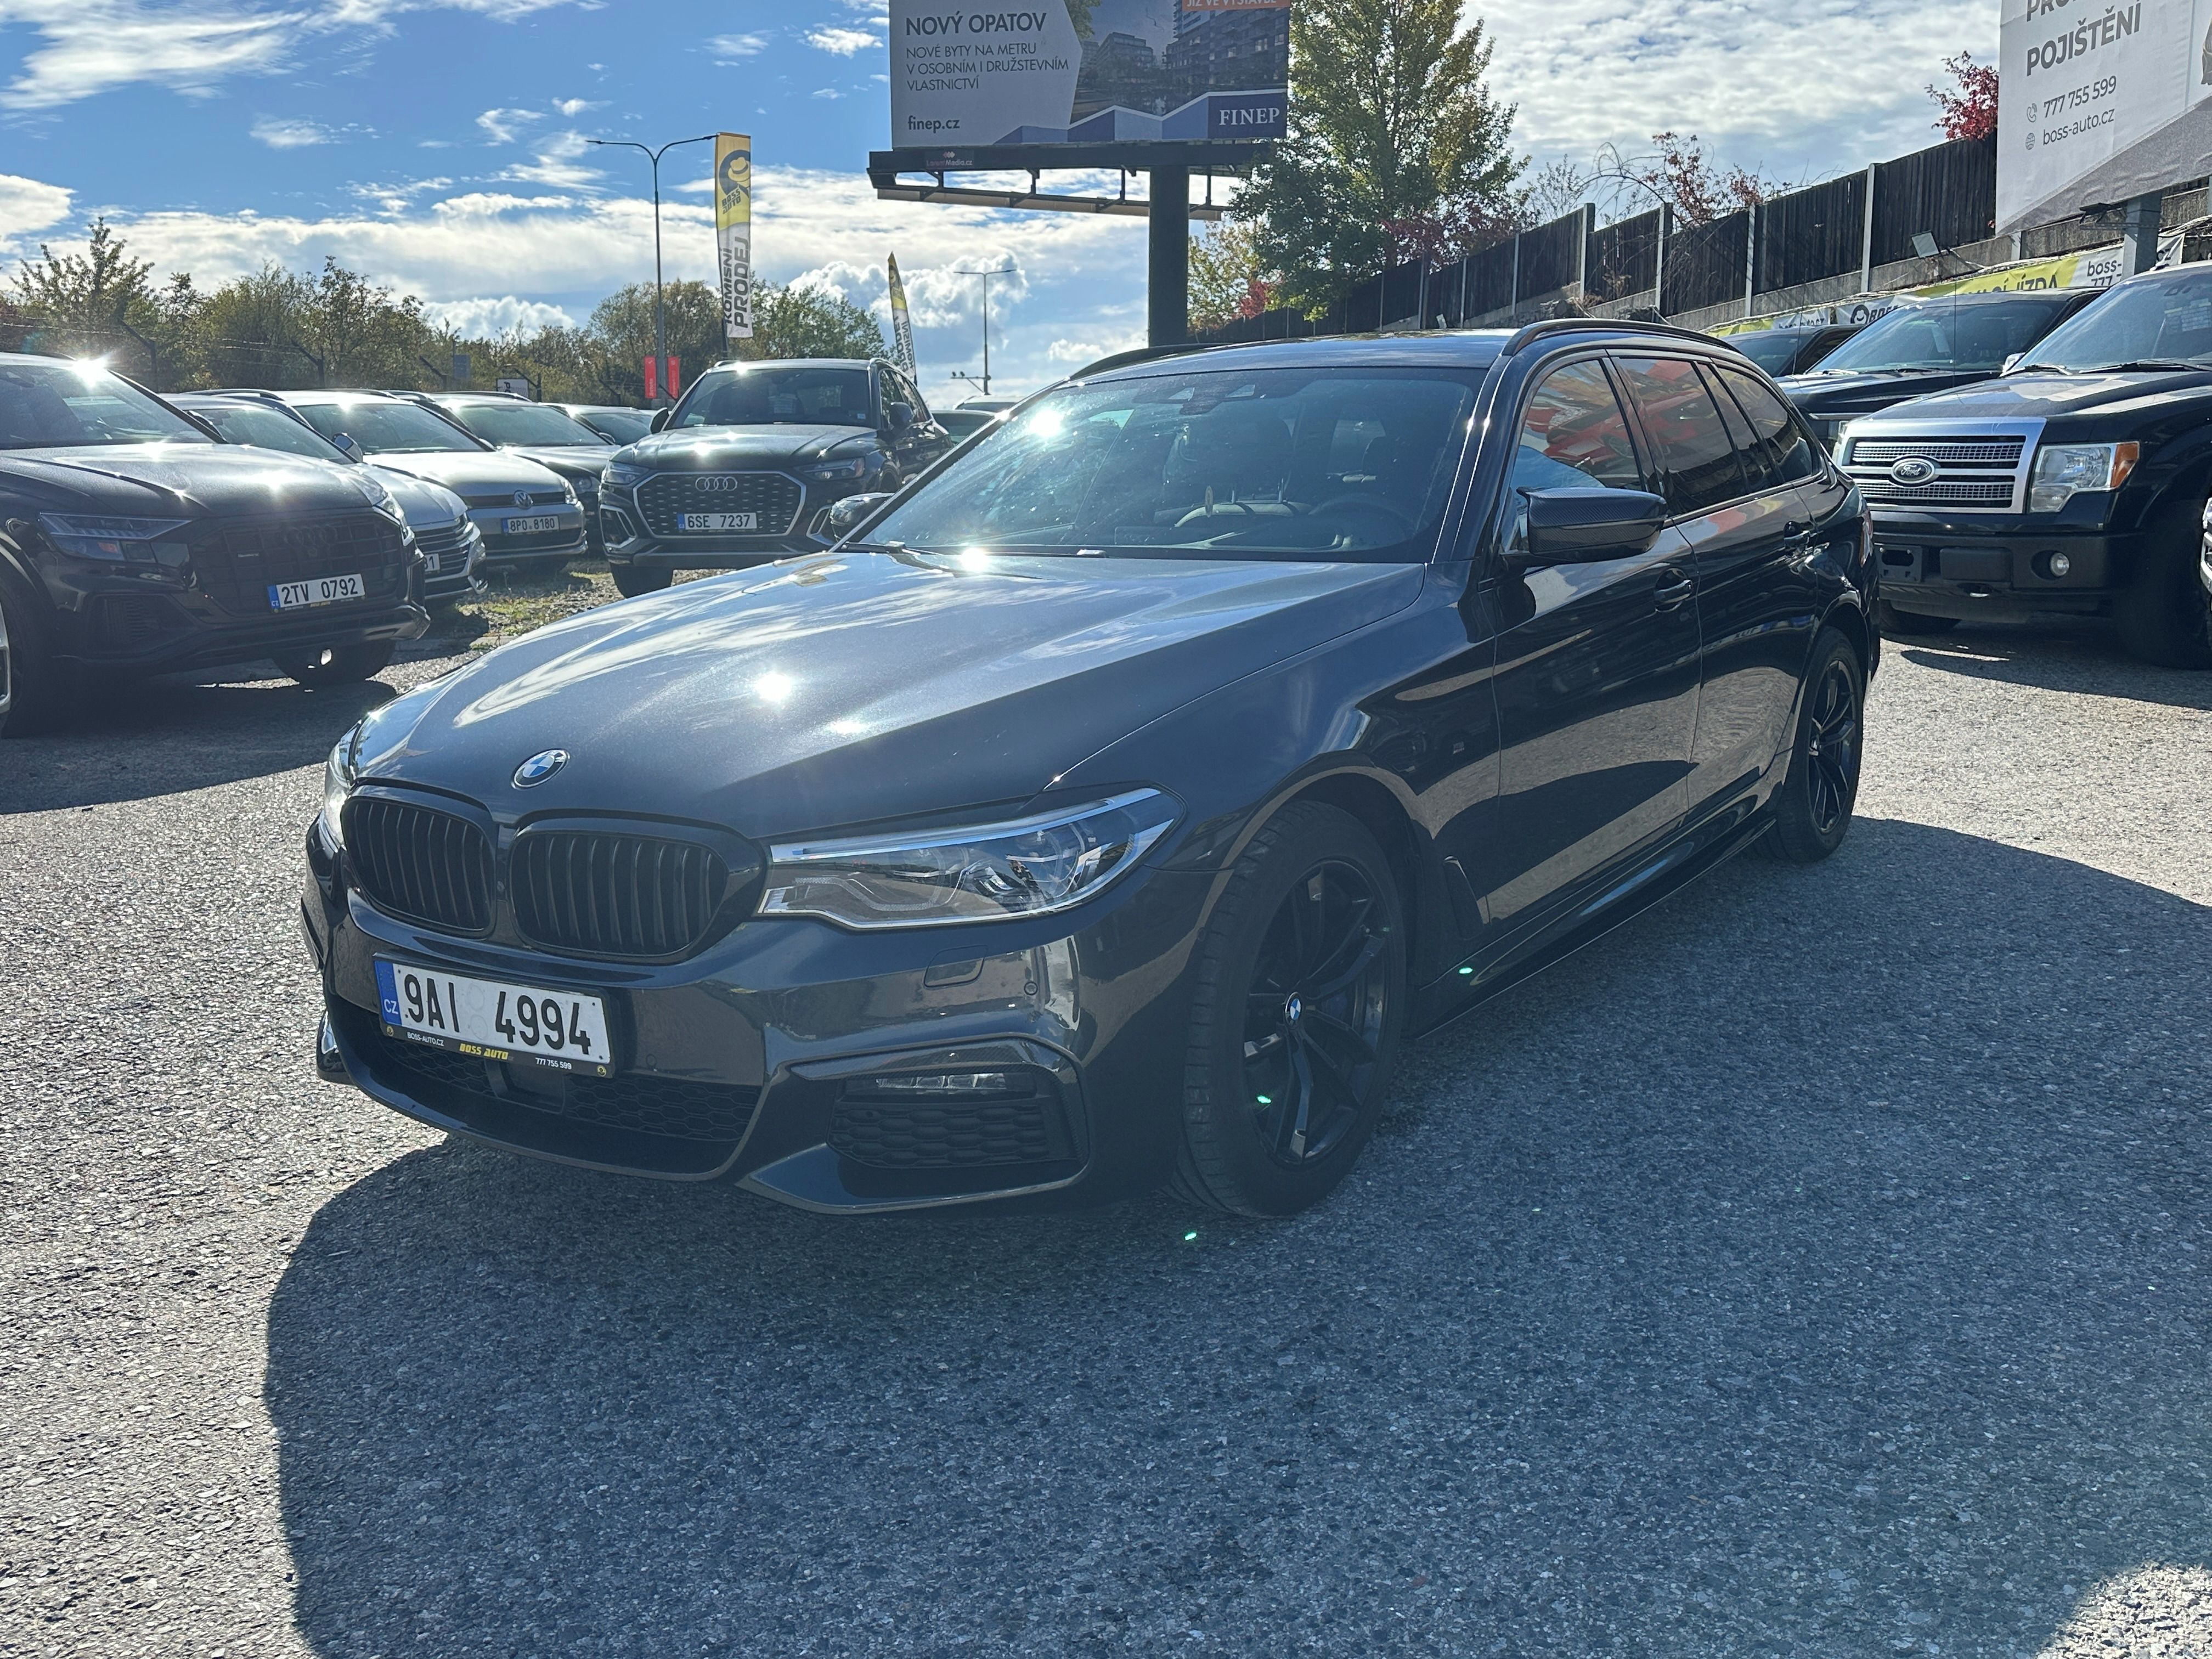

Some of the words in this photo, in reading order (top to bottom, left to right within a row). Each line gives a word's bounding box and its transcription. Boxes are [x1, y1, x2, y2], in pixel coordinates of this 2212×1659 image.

[906, 10, 963, 36] NOVÝ
[968, 12, 1047, 33] OPATOV
[2027, 0, 2141, 77] POJIŠTĚNÍ
[906, 44, 941, 59] NOVÉ
[945, 45, 971, 57] BYTY
[975, 44, 994, 56] NA
[997, 42, 1036, 55] METRU
[906, 64, 915, 75] V
[918, 59, 976, 74] OSOBNÍM
[979, 61, 983, 72] I
[987, 56, 1069, 72] DRUŽSTEVNÍM
[906, 75, 979, 91] VLASTNICTVÍ
[2044, 94, 2066, 118] 777
[2068, 85, 2090, 109] 755
[2092, 75, 2117, 100] 599
[907, 115, 960, 133] finep.cz
[1219, 108, 1280, 126] FINEP
[2042, 109, 2115, 145] boss-auto.cz
[722, 188, 741, 207] BOSS
[734, 236, 748, 328] PRODEJ
[1901, 465, 1921, 476] Ford
[533, 518, 555, 530] 8180
[687, 515, 710, 528] 6SE
[720, 515, 750, 527] 7237
[281, 583, 309, 605] 2TV
[321, 578, 358, 599] 0792
[384, 998, 399, 1015] CZ
[404, 974, 460, 1033] 9AI
[495, 991, 591, 1055] 4994
[407, 1031, 445, 1047] BOSS-AUTO.CZ
[459, 1043, 482, 1055] BOSS
[483, 1048, 509, 1060] AUTO
[535, 1057, 546, 1065] 777
[547, 1059, 559, 1068] 755
[560, 1061, 572, 1070] 599
